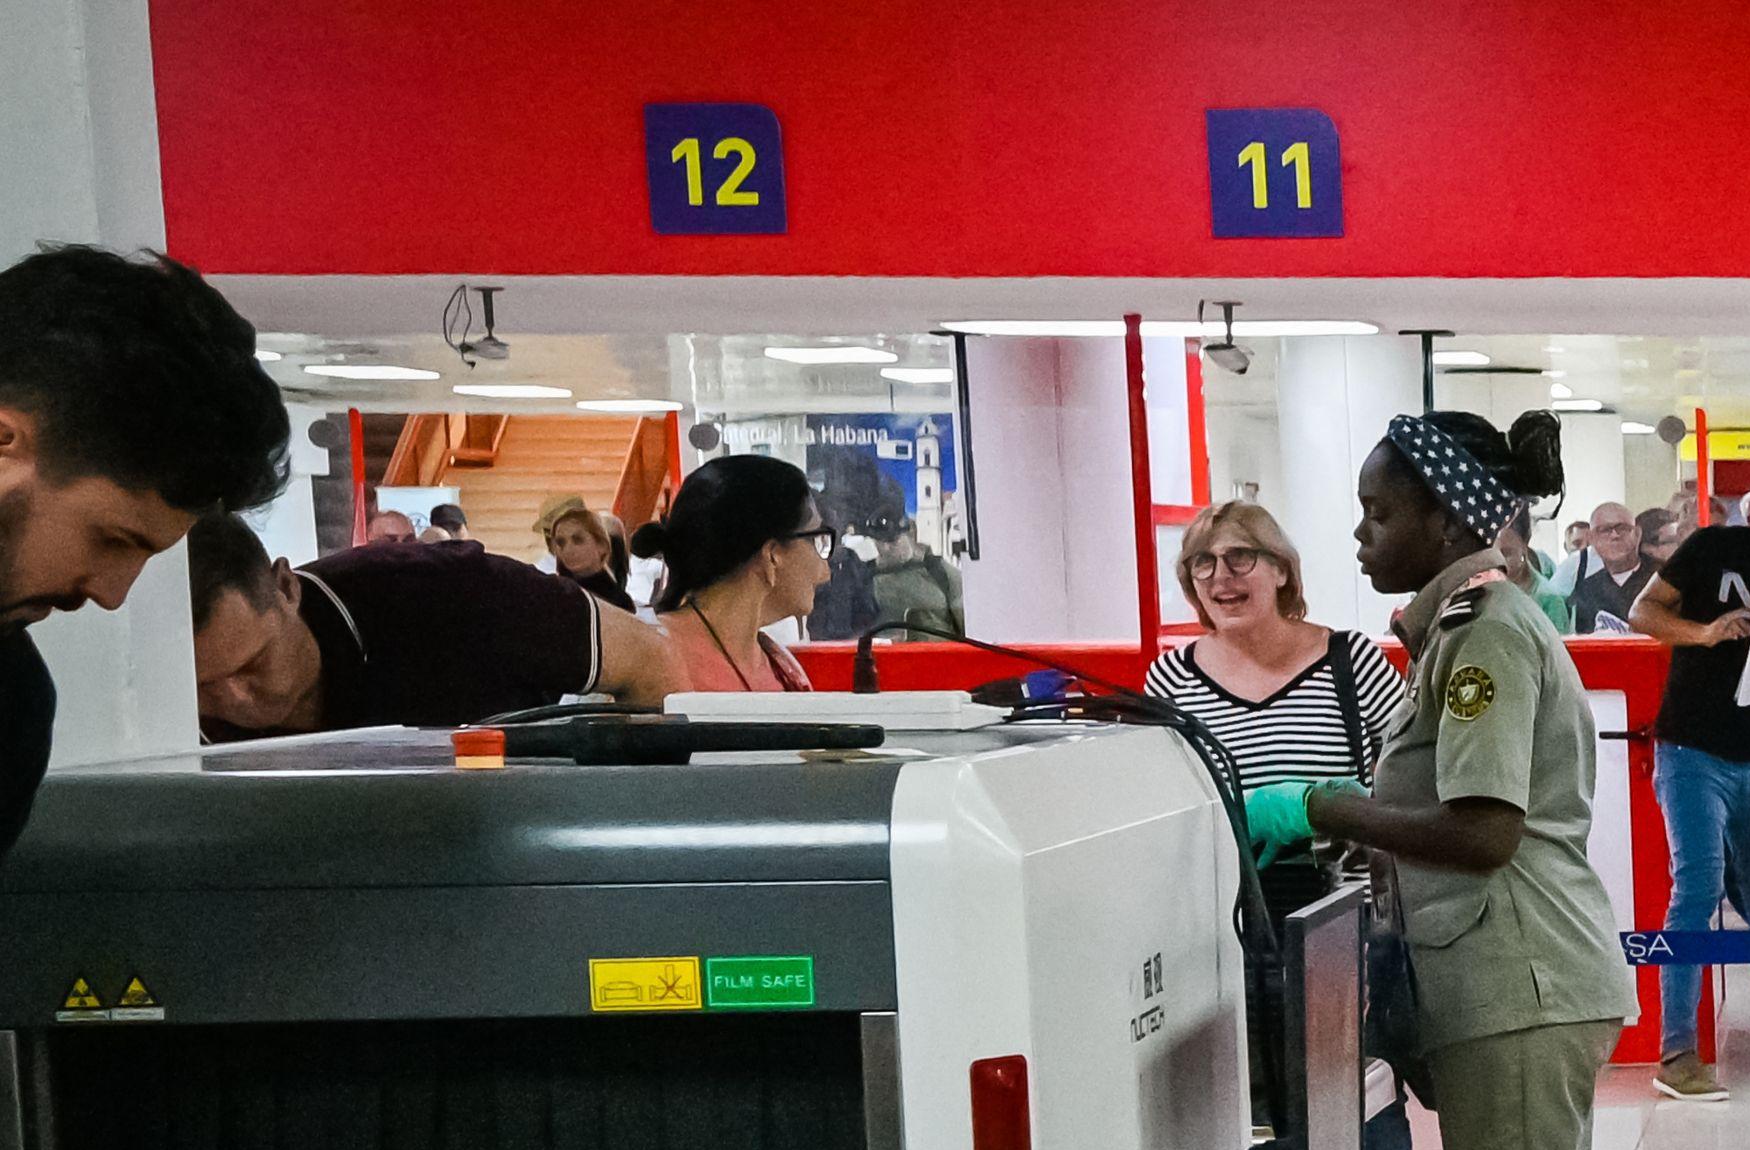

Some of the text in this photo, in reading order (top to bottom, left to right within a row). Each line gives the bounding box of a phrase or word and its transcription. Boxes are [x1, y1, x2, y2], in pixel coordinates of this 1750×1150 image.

[671, 137, 759, 206] 12
[1237, 141, 1312, 209] 11
[821, 423, 888, 445] Habana
[714, 973, 807, 989] FILM SAFE
